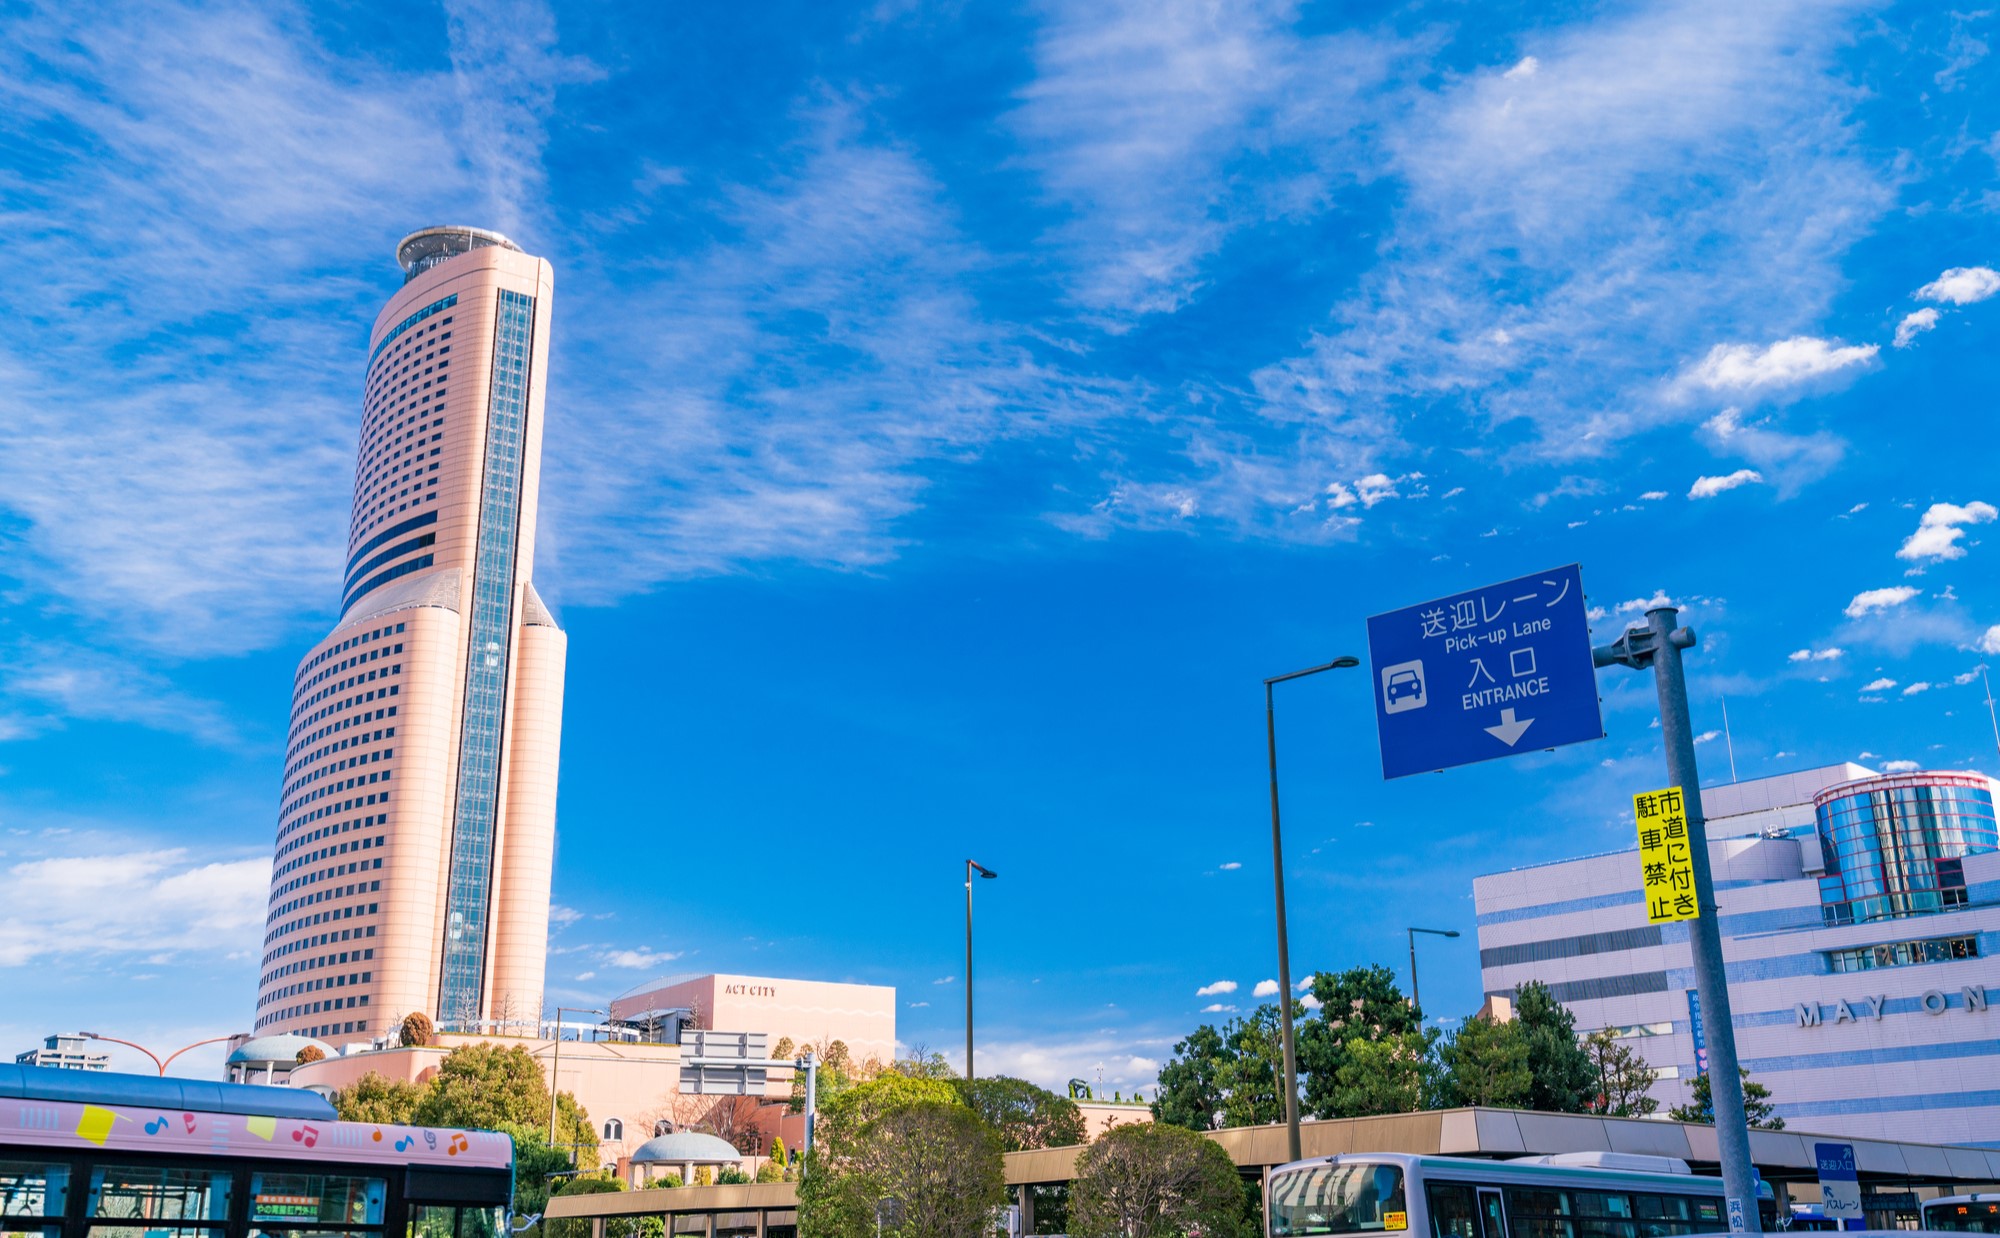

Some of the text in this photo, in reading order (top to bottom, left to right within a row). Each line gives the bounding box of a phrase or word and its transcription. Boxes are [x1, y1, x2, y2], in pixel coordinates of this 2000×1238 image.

[1420, 578, 1570, 639] 送迎レーン
[1445, 618, 1551, 654] Pick-up Lane
[1468, 647, 1537, 689] 入口
[1462, 677, 1549, 711] ENTRANCE
[1636, 795, 1672, 919] 駐車禁止
[1658, 791, 1694, 916] 市道に付き
[725, 984, 776, 997] ACT CITY
[1794, 994, 1886, 1027] MAY
[1820, 1160, 1853, 1171] 送迎入口
[1730, 1201, 1744, 1232] 浜松
[1826, 1200, 1859, 1210] バスレーン
